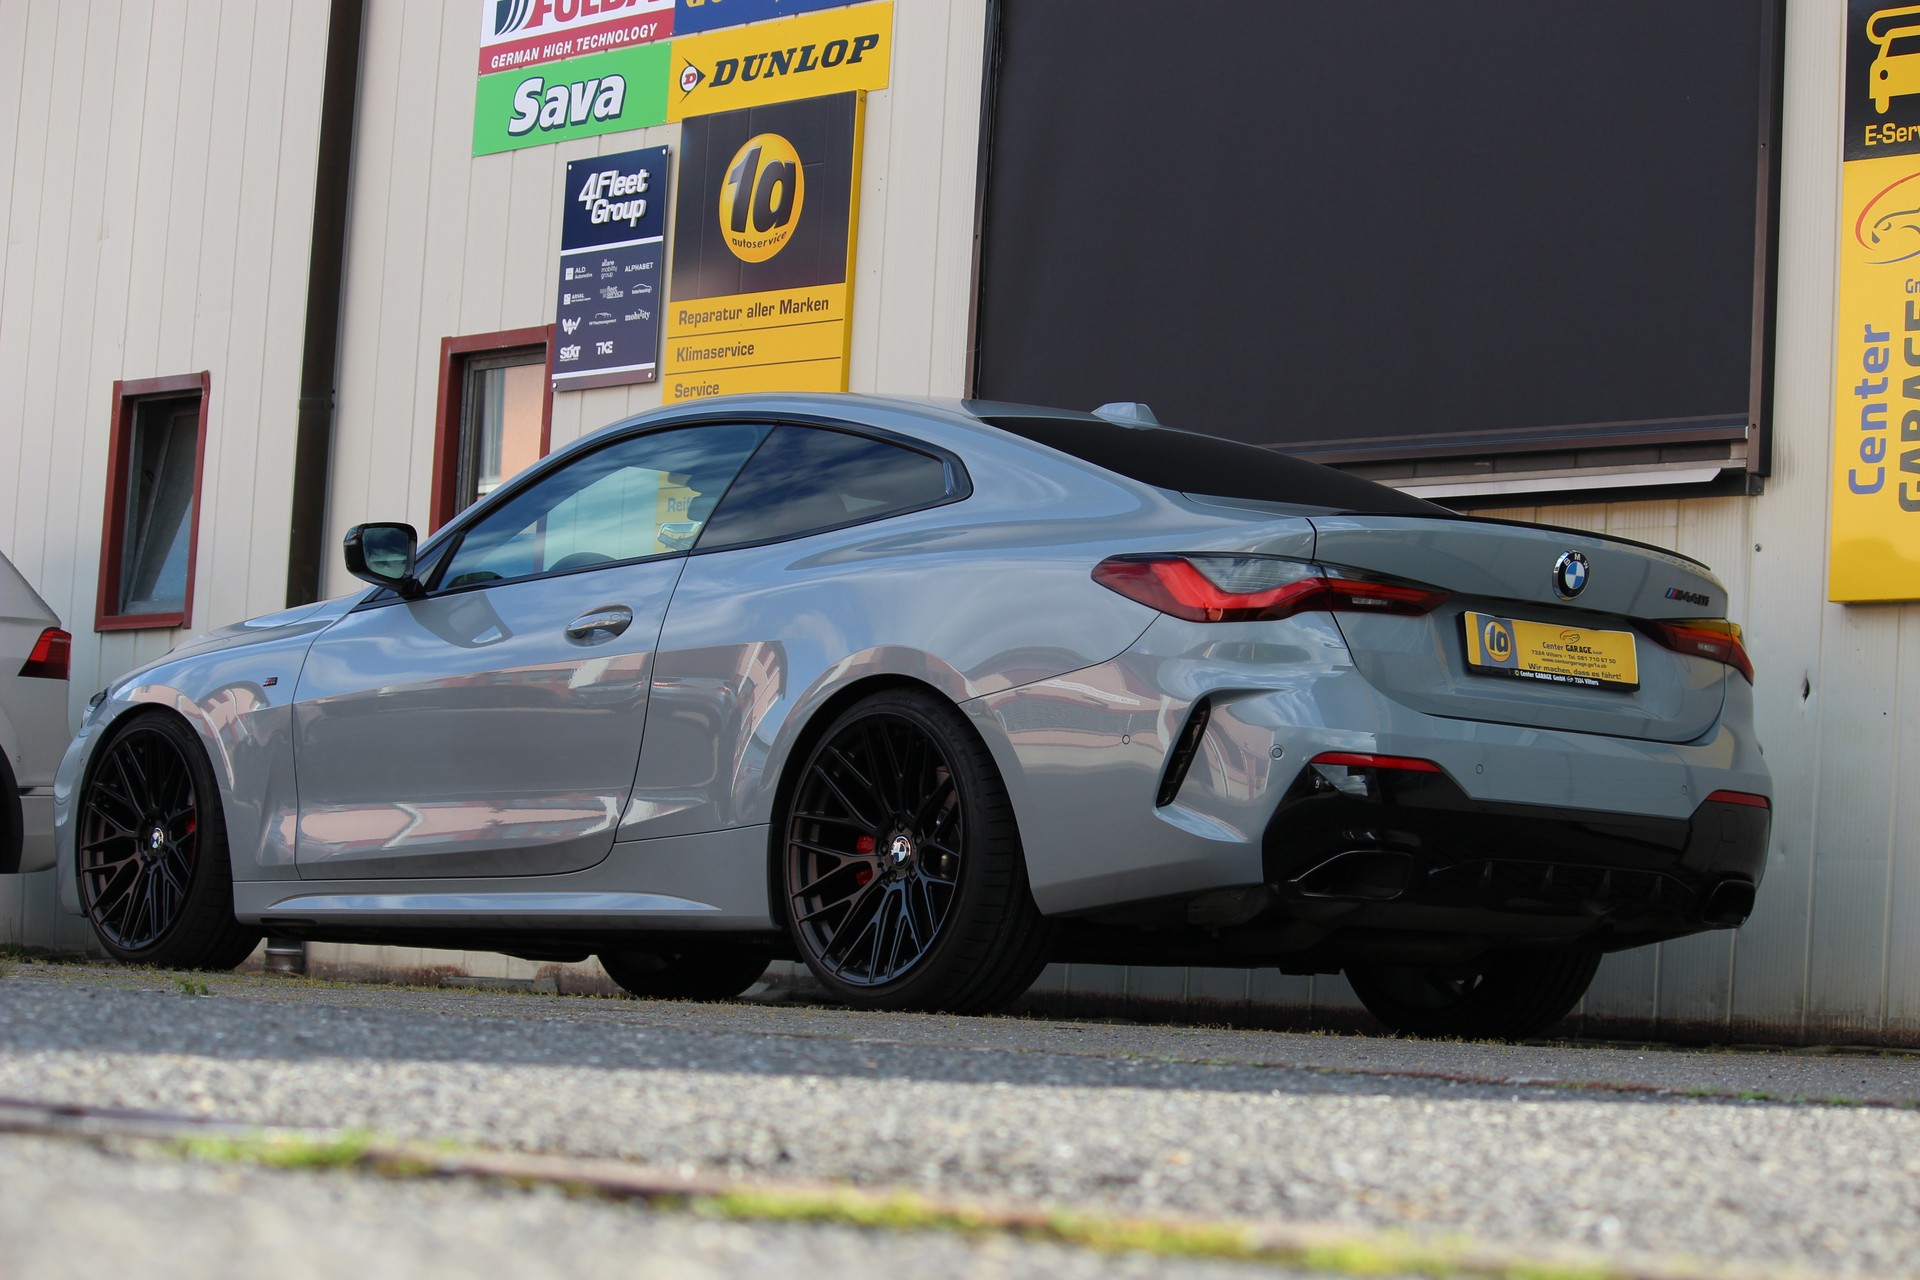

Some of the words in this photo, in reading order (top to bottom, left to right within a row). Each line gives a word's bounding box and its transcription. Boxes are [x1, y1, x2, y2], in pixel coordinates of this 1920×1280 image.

[491, 47, 539, 69] GERMAN
[542, 41, 573, 58] HIGH
[576, 23, 658, 52] TECHNOLOGY
[708, 33, 880, 88] DUNLOP
[508, 74, 627, 137] Sava
[578, 169, 650, 210] 4Fleet
[728, 145, 797, 234] 1a
[591, 199, 647, 228] Group
[731, 230, 787, 249] autoservice
[574, 266, 586, 274] ALD
[601, 272, 613, 280] group
[624, 262, 654, 273] ALPHABET
[678, 308, 743, 328] Reparatur
[746, 302, 775, 319] aller
[779, 297, 829, 315] Marken
[676, 341, 755, 362] Klimaservice
[674, 381, 720, 398] Service
[1848, 323, 1890, 495] Center
[667, 496, 692, 513] Reif
[1563, 553, 1589, 570] BMW
[1542, 641, 1564, 651] Center
[1566, 644, 1592, 654] GARAGE
[1528, 662, 1541, 671] Wir
[1543, 665, 1572, 675] machen,
